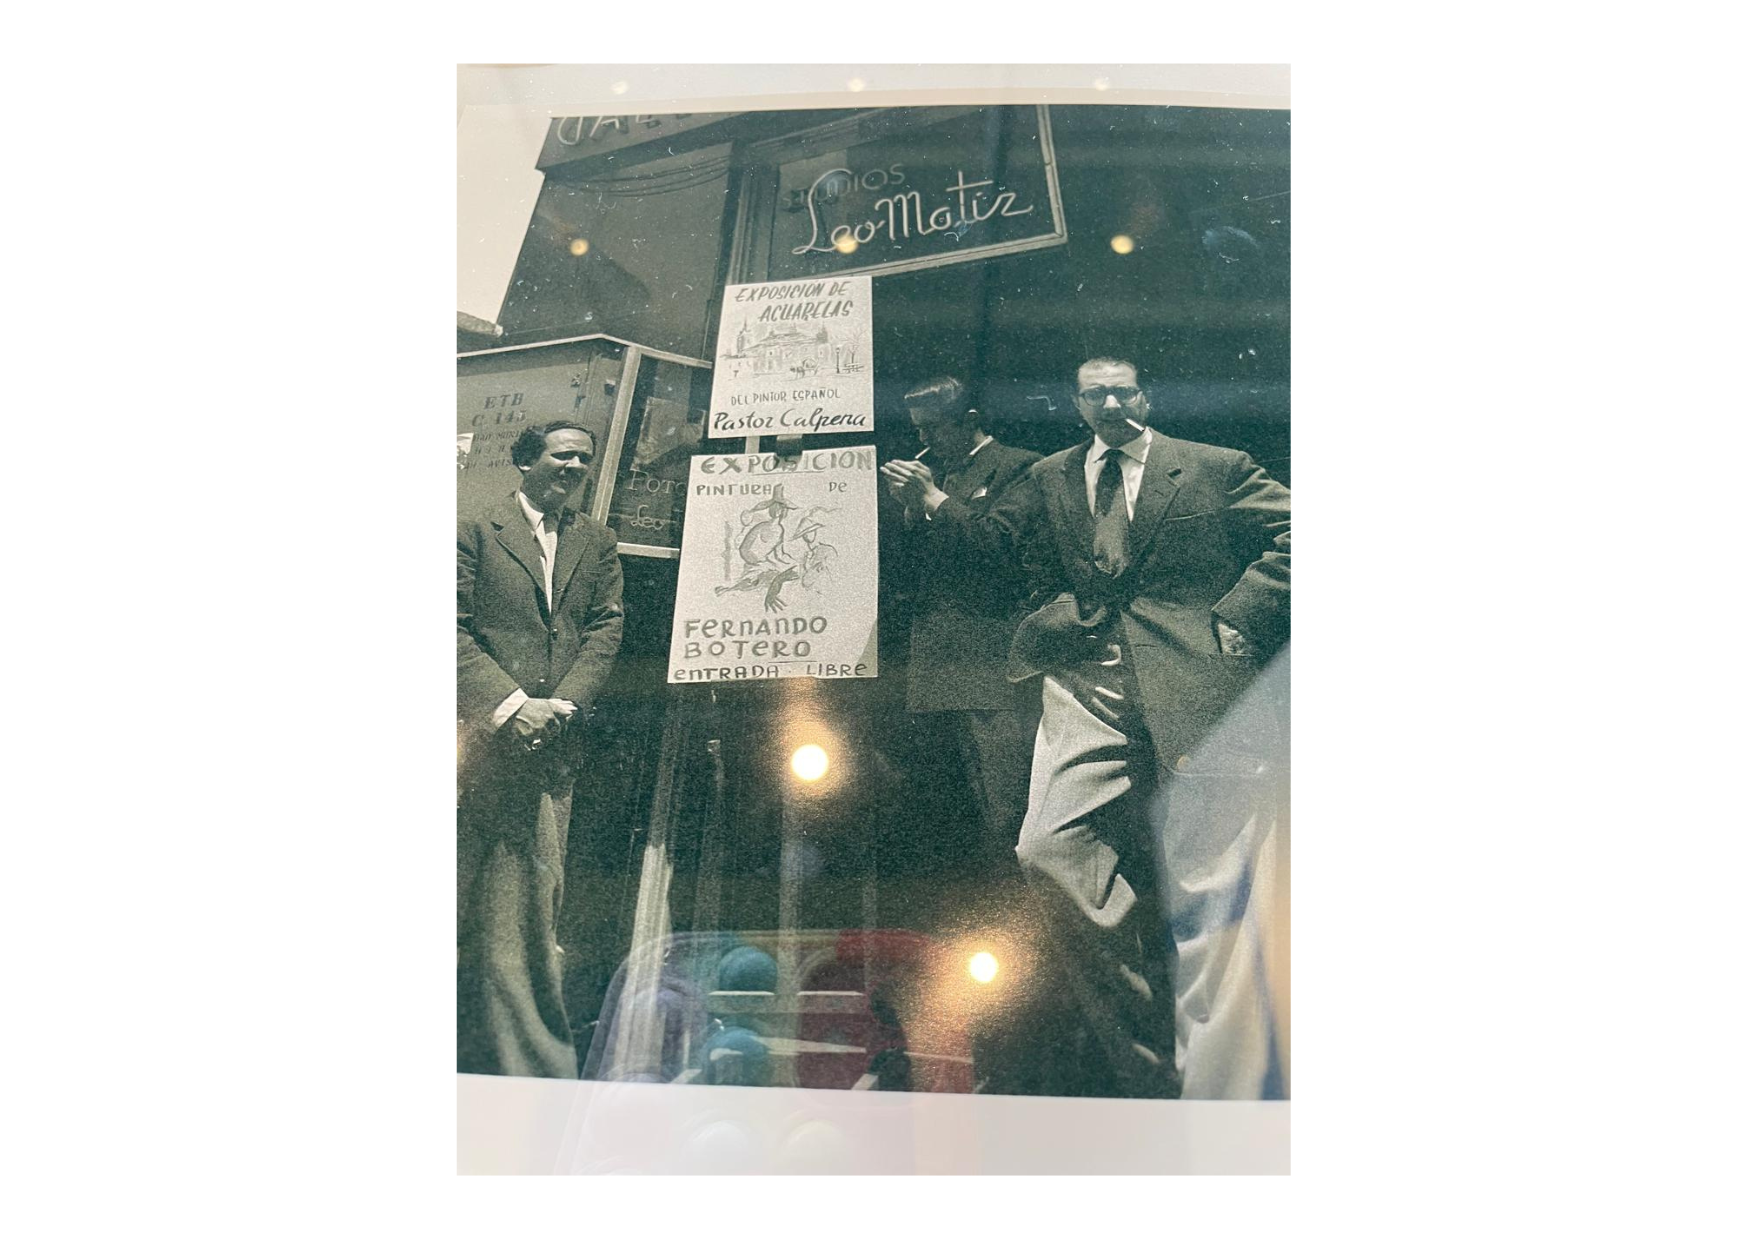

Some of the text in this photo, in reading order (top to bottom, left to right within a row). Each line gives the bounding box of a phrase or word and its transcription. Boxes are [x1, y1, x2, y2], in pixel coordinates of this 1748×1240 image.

[875, 169, 1034, 240] Matiz
[829, 281, 851, 296] DE
[758, 300, 853, 323] ACUARELAS
[731, 386, 841, 406] DEL PINTOR ESPAÑOL
[713, 407, 867, 432] Pastor Calpena
[701, 451, 872, 475] EXPOSICION
